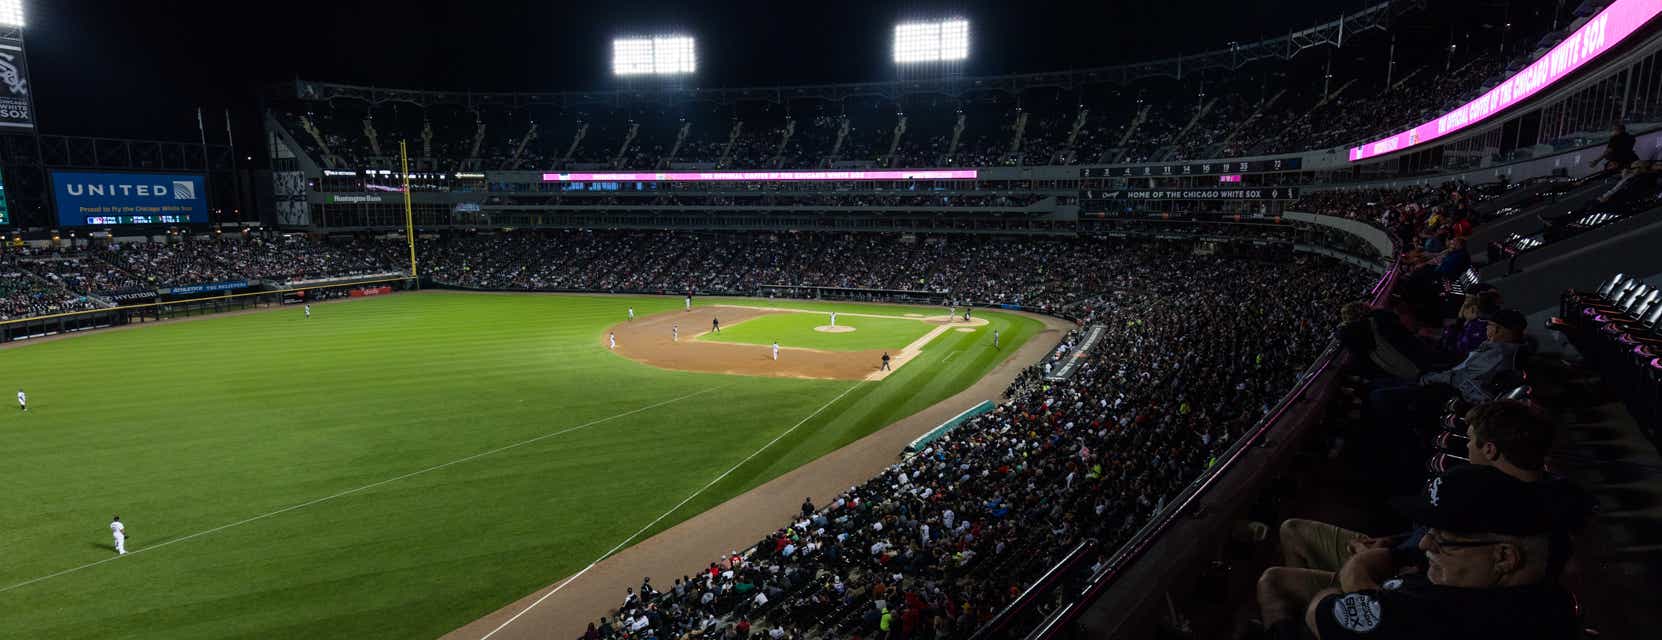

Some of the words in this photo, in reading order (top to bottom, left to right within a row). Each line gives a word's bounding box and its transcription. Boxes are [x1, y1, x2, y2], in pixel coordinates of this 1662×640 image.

[1513, 56, 1550, 99] CHICAGO
[1550, 32, 1582, 77] WHITE
[1581, 13, 1609, 58] SOX
[0, 110, 28, 119] SOX
[67, 183, 167, 196] UNITED
[1220, 190, 1244, 198] WHITE
[1245, 190, 1262, 198] SOX
[334, 194, 365, 203] Huntington
[114, 291, 157, 300] HYUNDAI
